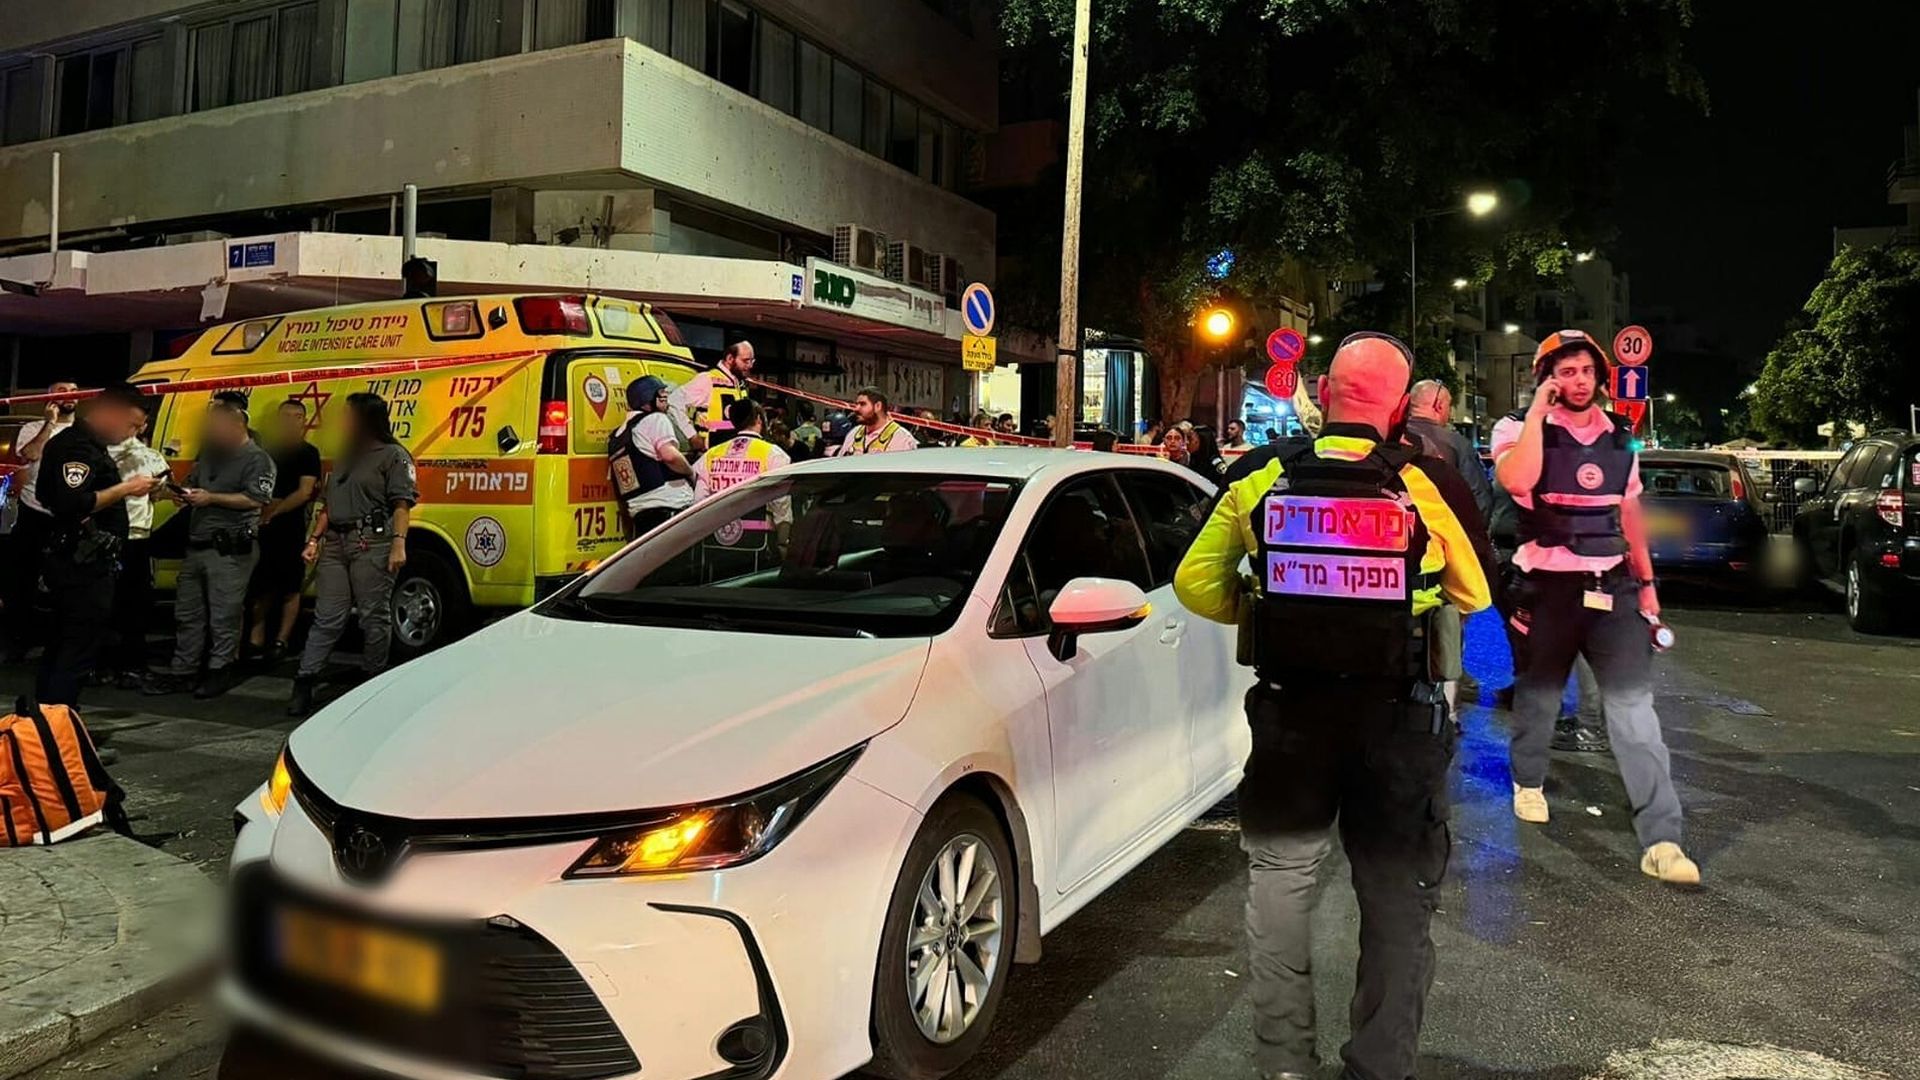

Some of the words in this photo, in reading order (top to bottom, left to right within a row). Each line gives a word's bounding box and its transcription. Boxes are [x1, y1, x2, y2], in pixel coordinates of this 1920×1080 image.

[233, 250, 240, 264] 7
[793, 277, 802, 290] 23
[286, 321, 321, 338] נמרץ
[326, 316, 364, 332] טיפול
[368, 315, 408, 330] ניידת
[278, 338, 309, 353] MOBILE
[310, 336, 354, 351] INTENSIVE
[354, 335, 379, 349] CARE
[380, 334, 404, 348] UNIT
[1622, 336, 1643, 355] 30
[393, 379, 422, 399] מגן
[449, 376, 504, 398] ירקון
[1274, 371, 1296, 388] 30
[449, 406, 487, 438] 175
[446, 472, 528, 494] פראמדיק
[575, 506, 606, 537] 175
[1269, 503, 1404, 538] פראמדיק
[1336, 564, 1399, 593] מפקד
